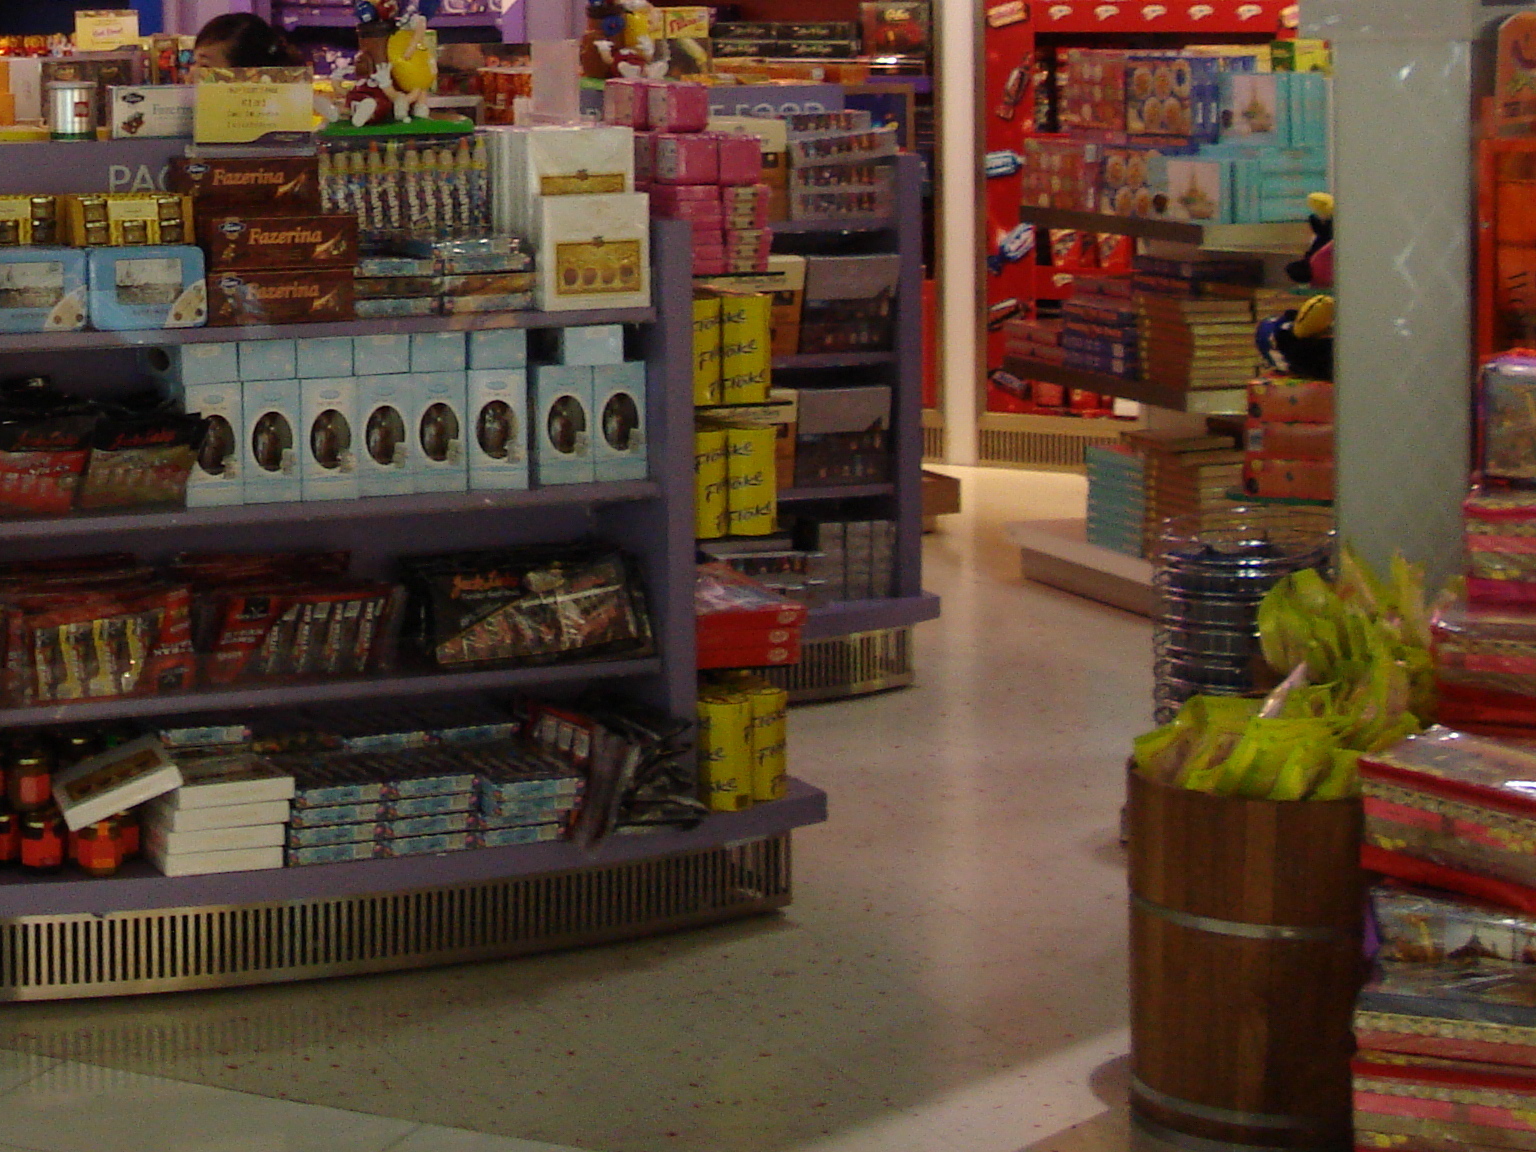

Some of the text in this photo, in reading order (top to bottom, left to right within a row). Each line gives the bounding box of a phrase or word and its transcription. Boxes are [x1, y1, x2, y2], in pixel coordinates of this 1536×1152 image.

[212, 168, 284, 185] Fazerina
[248, 227, 322, 244] Fazerina
[246, 281, 320, 299] Fazerina
